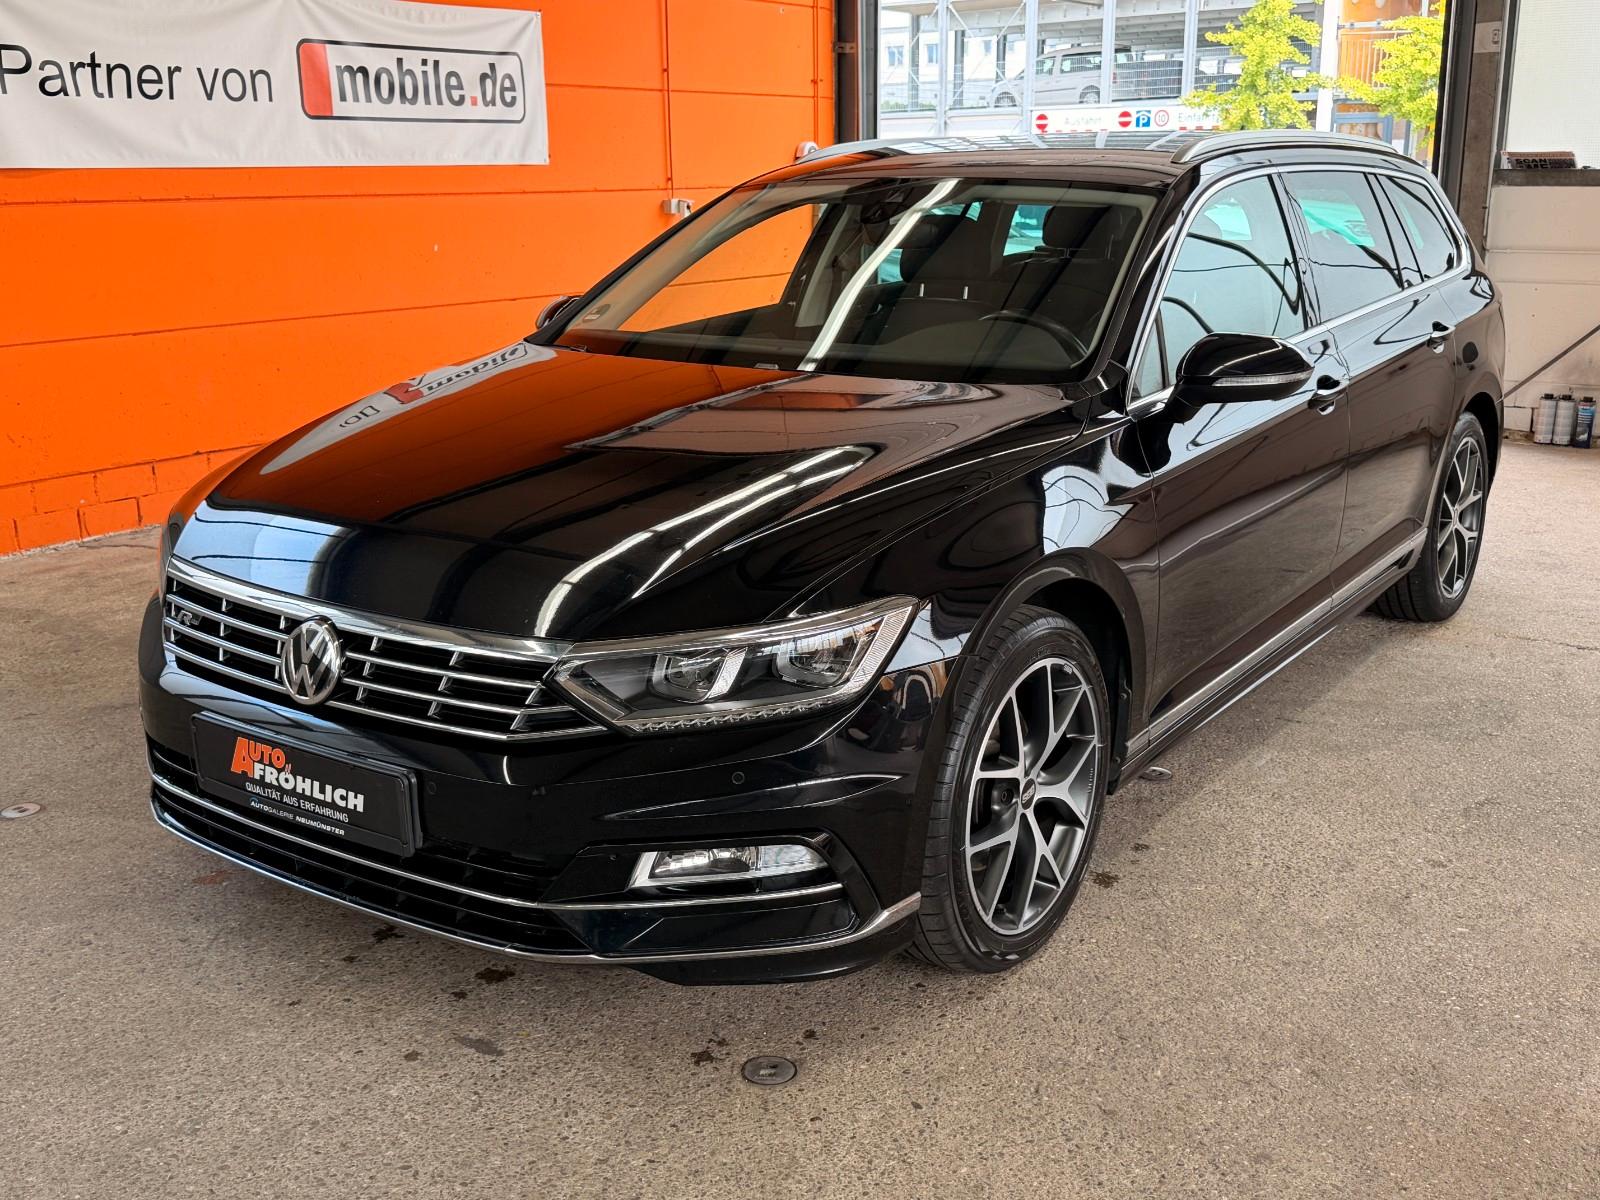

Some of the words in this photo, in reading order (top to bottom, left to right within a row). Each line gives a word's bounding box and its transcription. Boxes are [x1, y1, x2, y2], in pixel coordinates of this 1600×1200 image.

[0, 44, 181, 101] Partner
[197, 66, 274, 103] von
[335, 57, 518, 109] mobile.de
[1158, 114, 1166, 123] 10
[231, 737, 286, 777] AUTO
[246, 782, 281, 802] QUALITÄT
[283, 795, 298, 807] AUS
[300, 800, 349, 823] ERFAHRUNG
[253, 763, 365, 813] FRÖHLICH
[250, 800, 294, 820] AUTOGALERIE
[295, 815, 345, 836] NEUMÜNSTER
